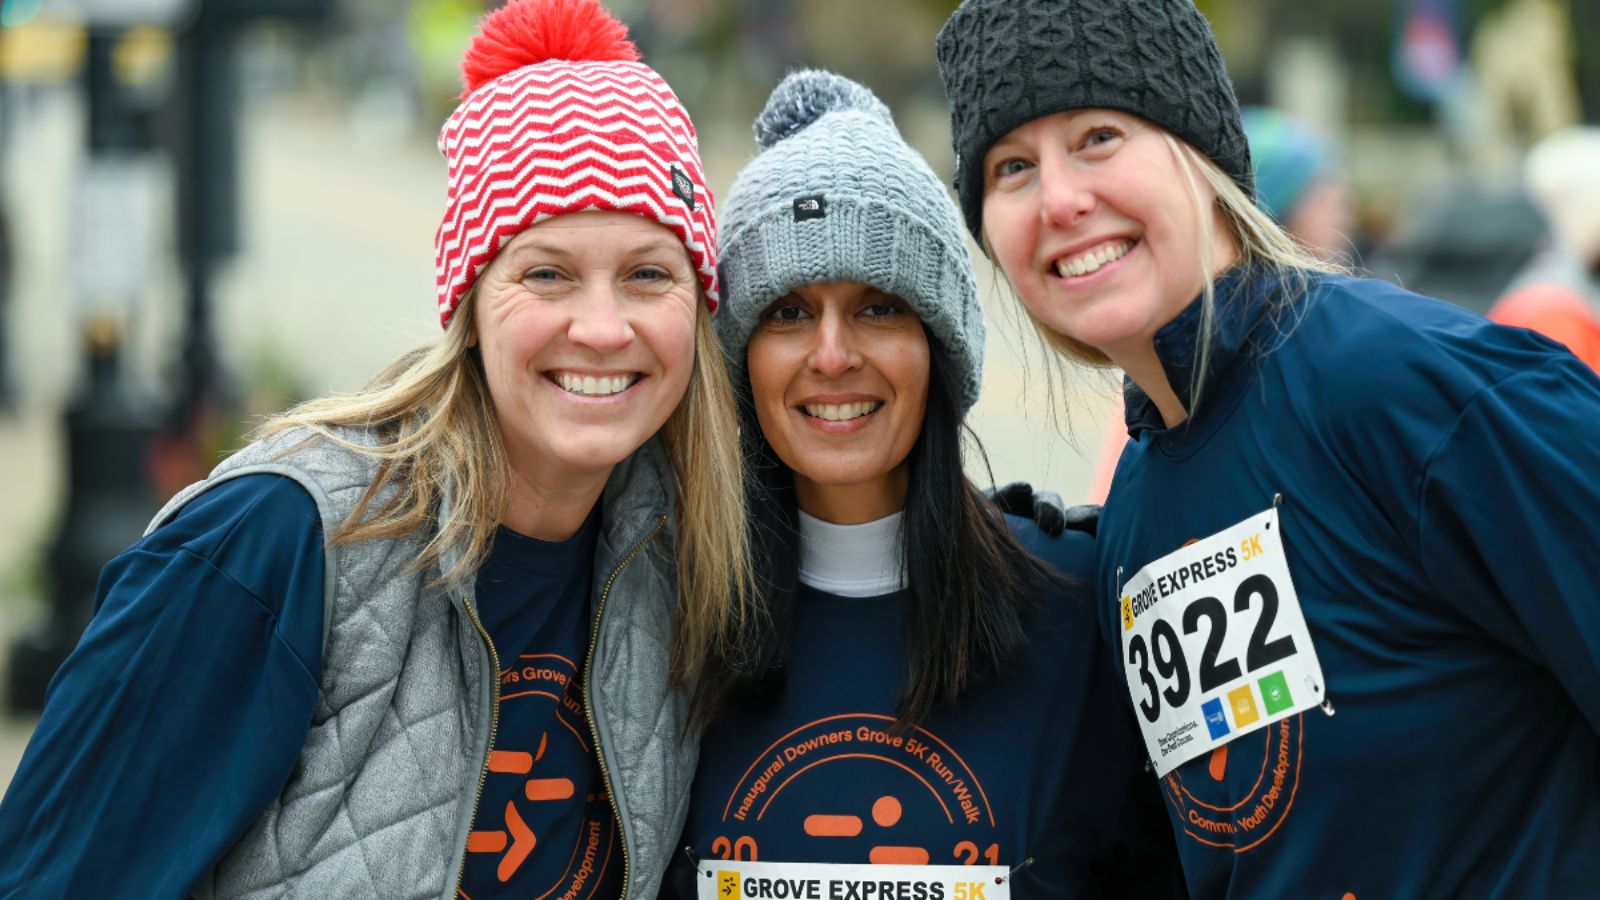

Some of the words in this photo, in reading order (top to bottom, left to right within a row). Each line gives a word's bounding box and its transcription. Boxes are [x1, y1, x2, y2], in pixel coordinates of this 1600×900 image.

[1132, 582, 1158, 618] GROVE
[1157, 547, 1238, 598] EXPRESS
[1240, 533, 1264, 562] 5K
[522, 666, 567, 685] Grove
[1129, 573, 1298, 723] 3922
[733, 754, 785, 821] Inaugural
[784, 729, 853, 762] Downers
[856, 726, 903, 748] Grove
[905, 738, 929, 760] 5K
[926, 751, 980, 825] Run/Walk
[1237, 804, 1269, 832] Youth
[1261, 718, 1290, 810] Developmen
[556, 820, 601, 900] evelopment
[743, 877, 821, 900] GROVE
[828, 878, 945, 900] EXPRESS
[953, 881, 986, 900] 5K
